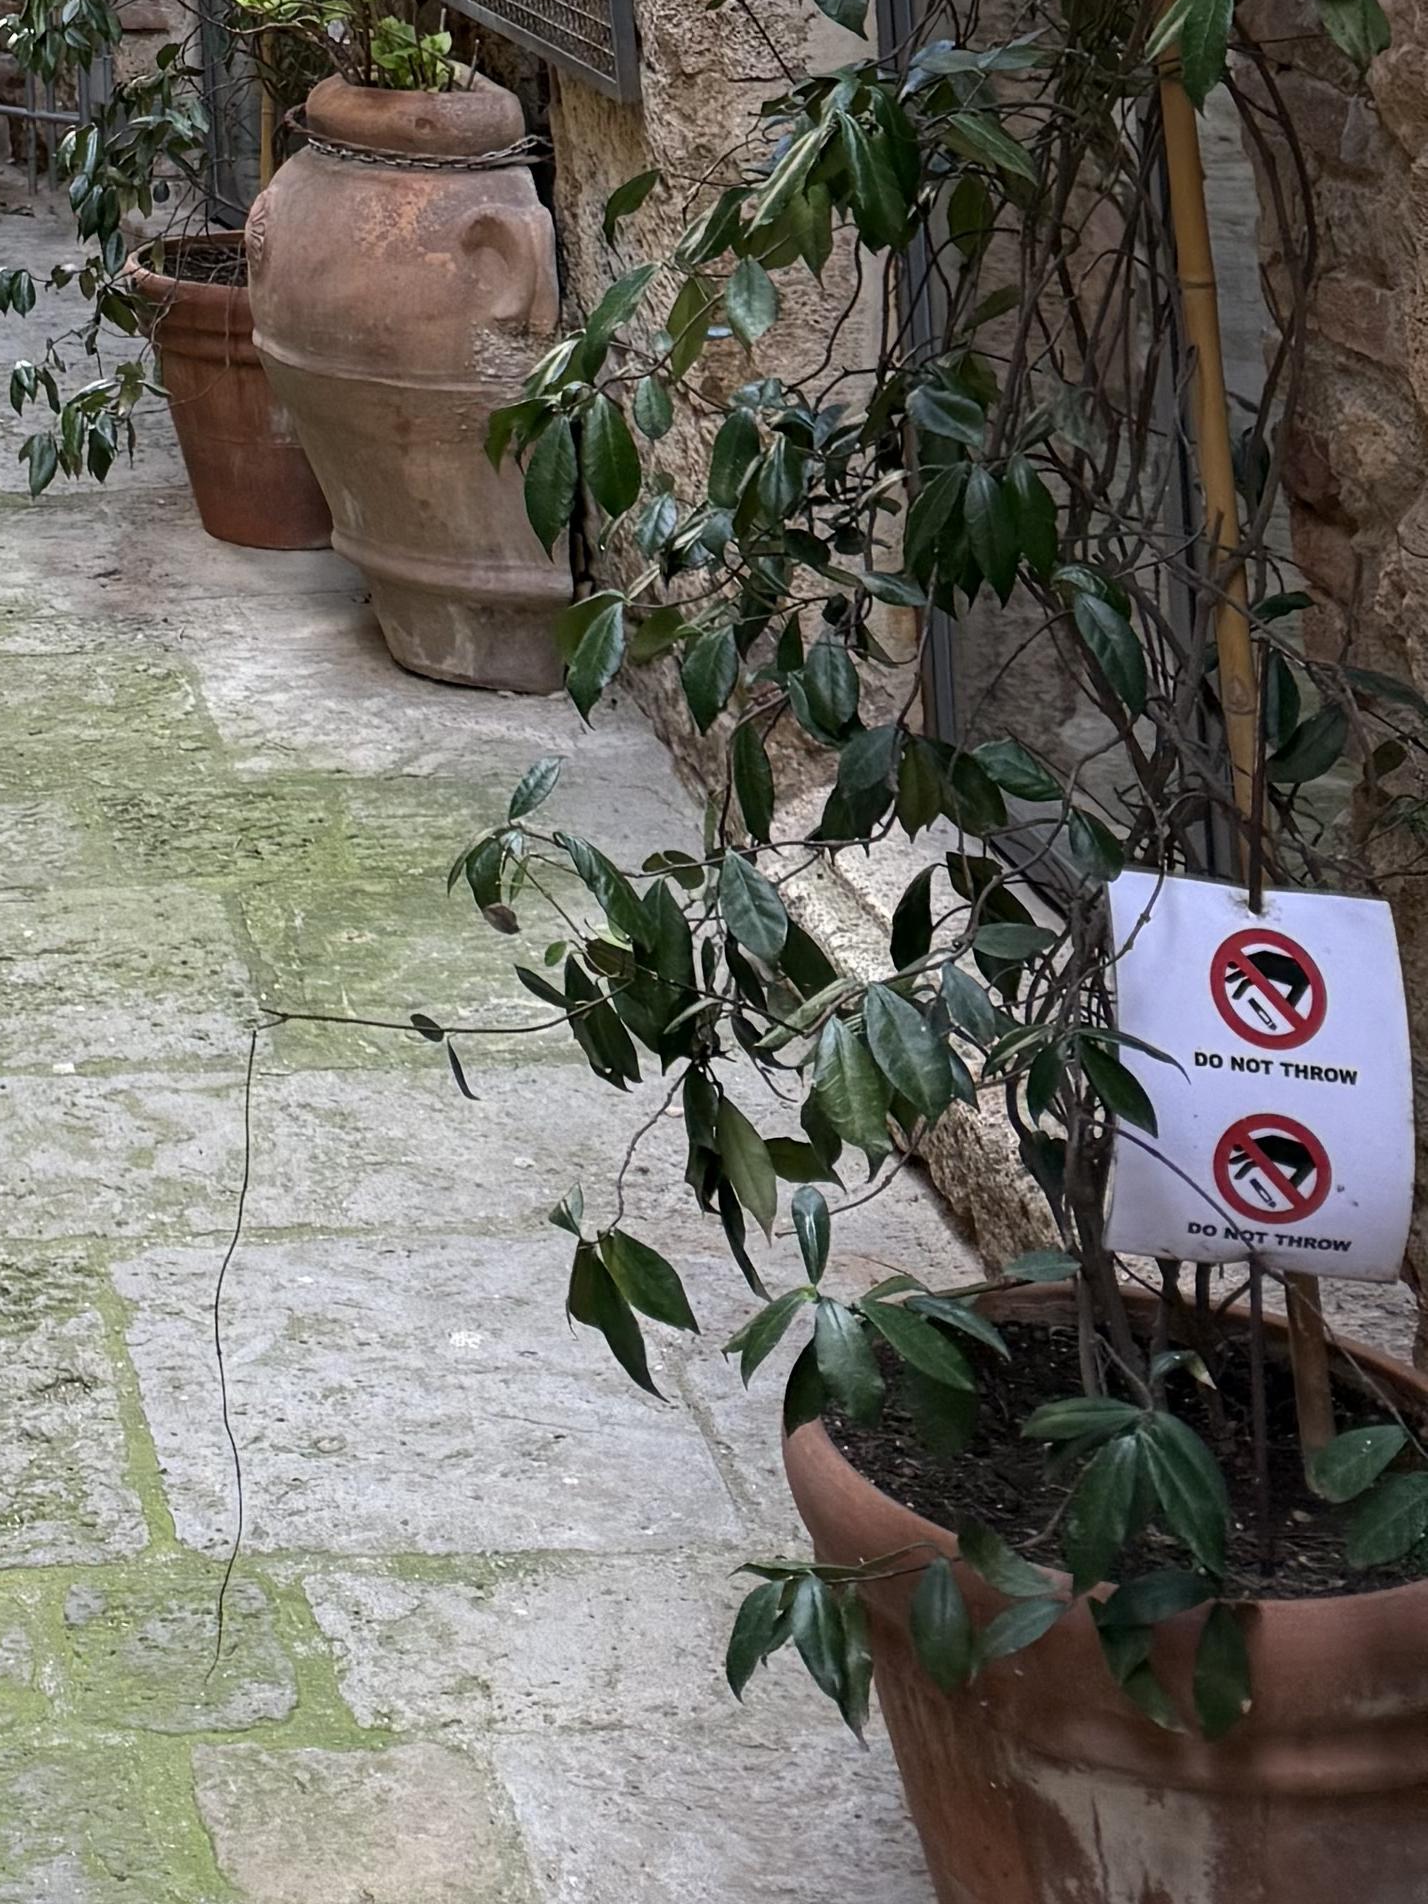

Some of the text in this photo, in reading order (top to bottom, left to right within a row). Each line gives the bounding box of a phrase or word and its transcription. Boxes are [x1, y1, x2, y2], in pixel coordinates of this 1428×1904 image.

[1194, 1051, 1358, 1086] DO NOT THROW
[1187, 1221, 1353, 1252] DO NOT THROW
